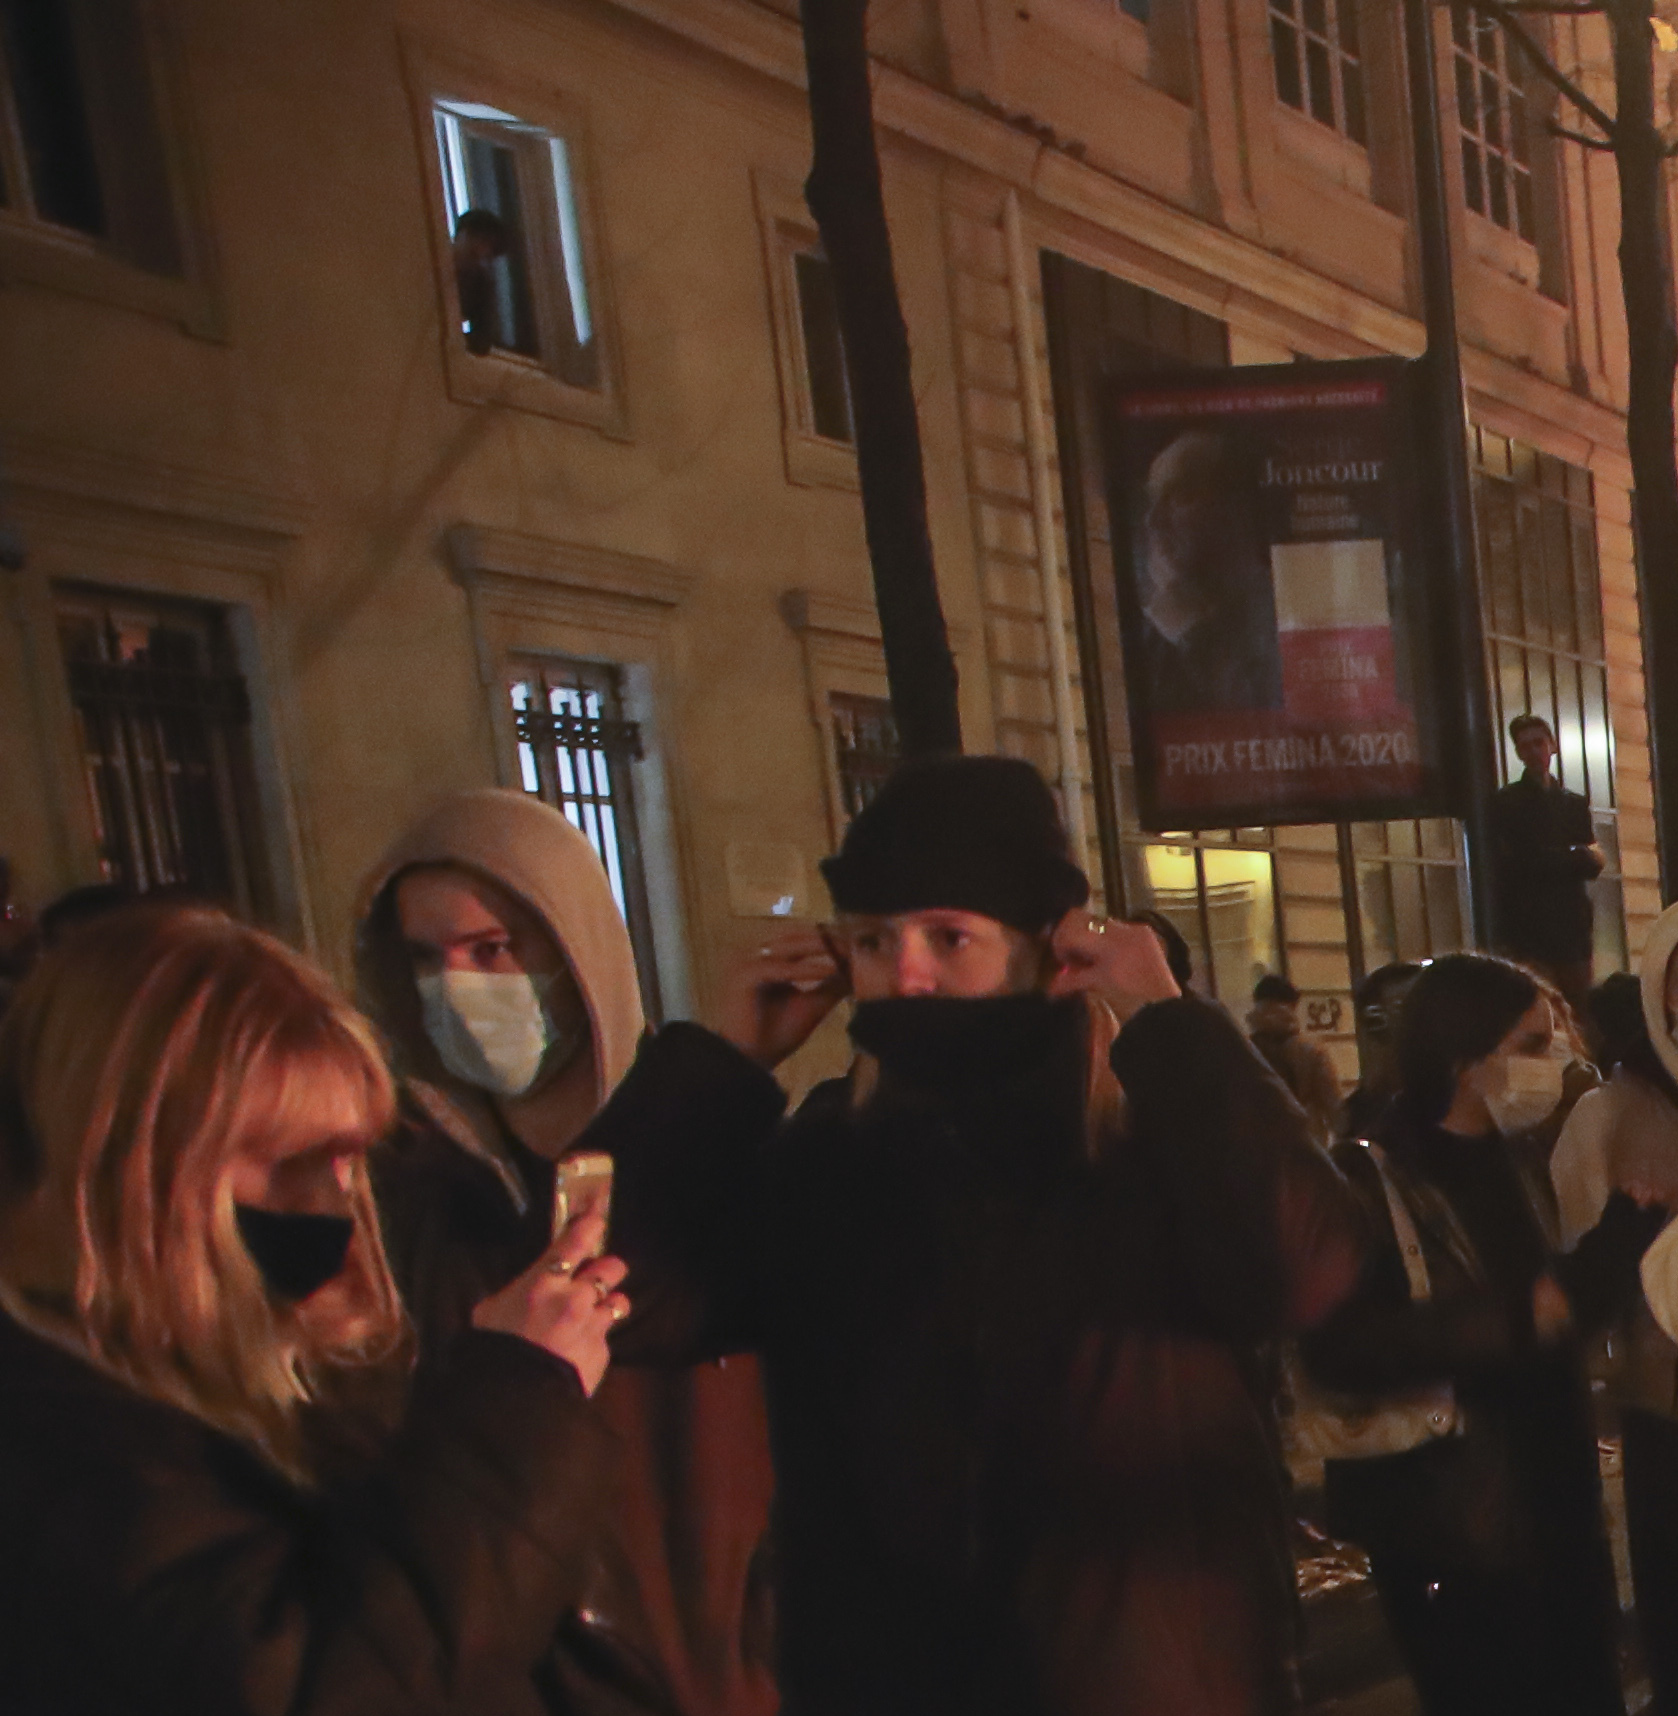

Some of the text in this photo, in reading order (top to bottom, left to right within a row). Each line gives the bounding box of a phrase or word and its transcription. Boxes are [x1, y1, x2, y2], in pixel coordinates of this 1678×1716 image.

[1258, 457, 1383, 487] Joncour
[1164, 732, 1411, 777] PRIX FEMINA 2020
